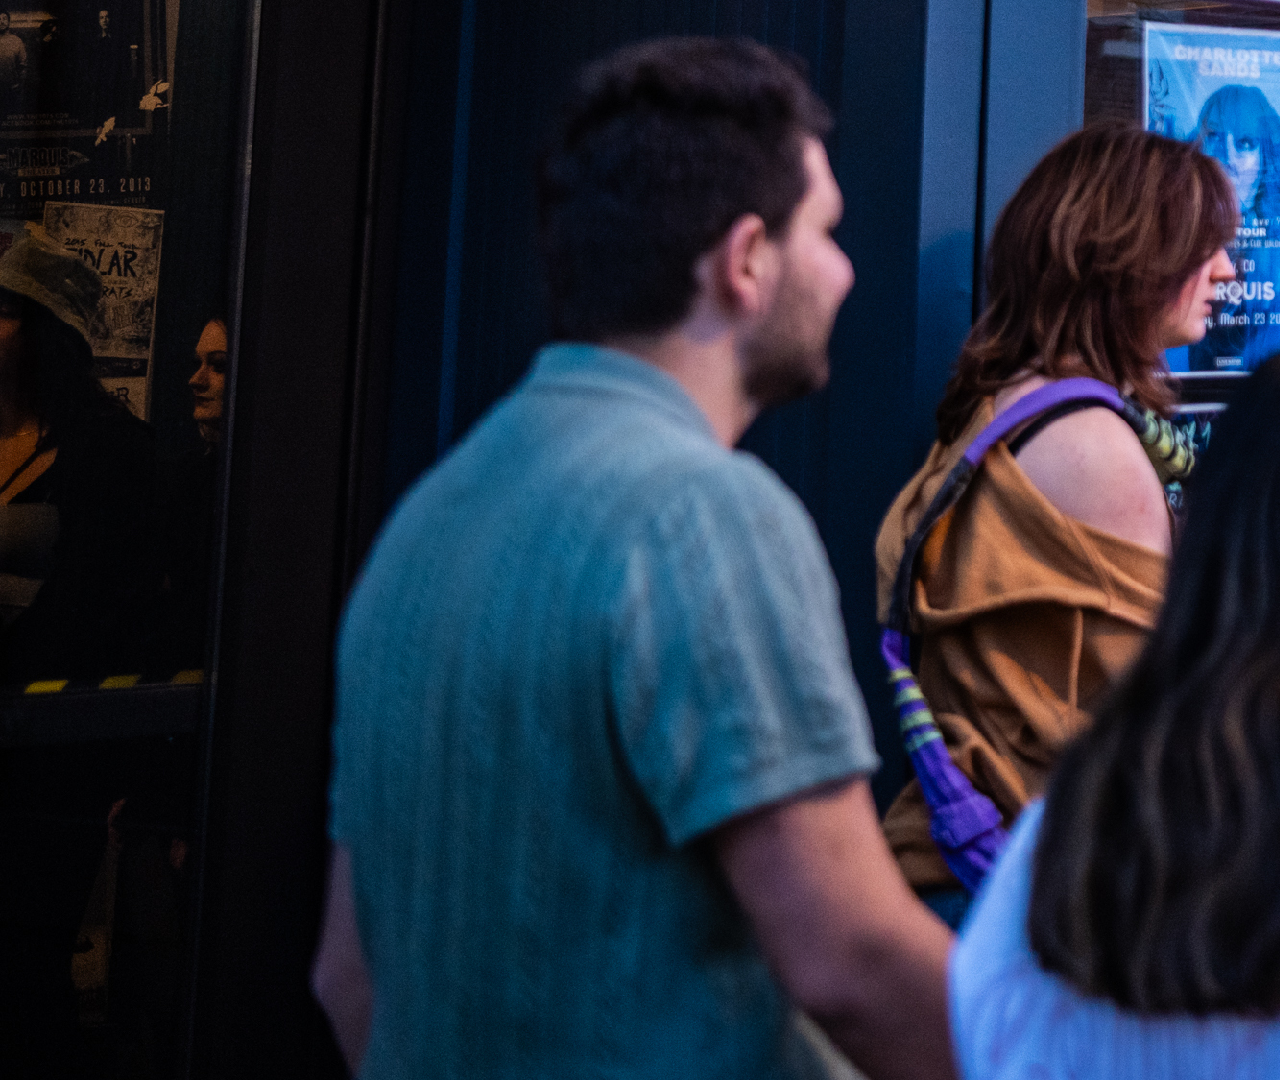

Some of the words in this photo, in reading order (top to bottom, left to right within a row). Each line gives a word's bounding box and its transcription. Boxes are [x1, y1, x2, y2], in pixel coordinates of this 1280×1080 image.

[1199, 58, 1261, 78] SANDS
[6, 146, 70, 168] MARQUIS
[20, 178, 82, 198] OCTOBER
[120, 176, 152, 193] 2013
[1235, 227, 1267, 238] TOUR
[1243, 260, 1255, 272] CO
[1220, 313, 1250, 326] March
[1254, 313, 1266, 325] 23
